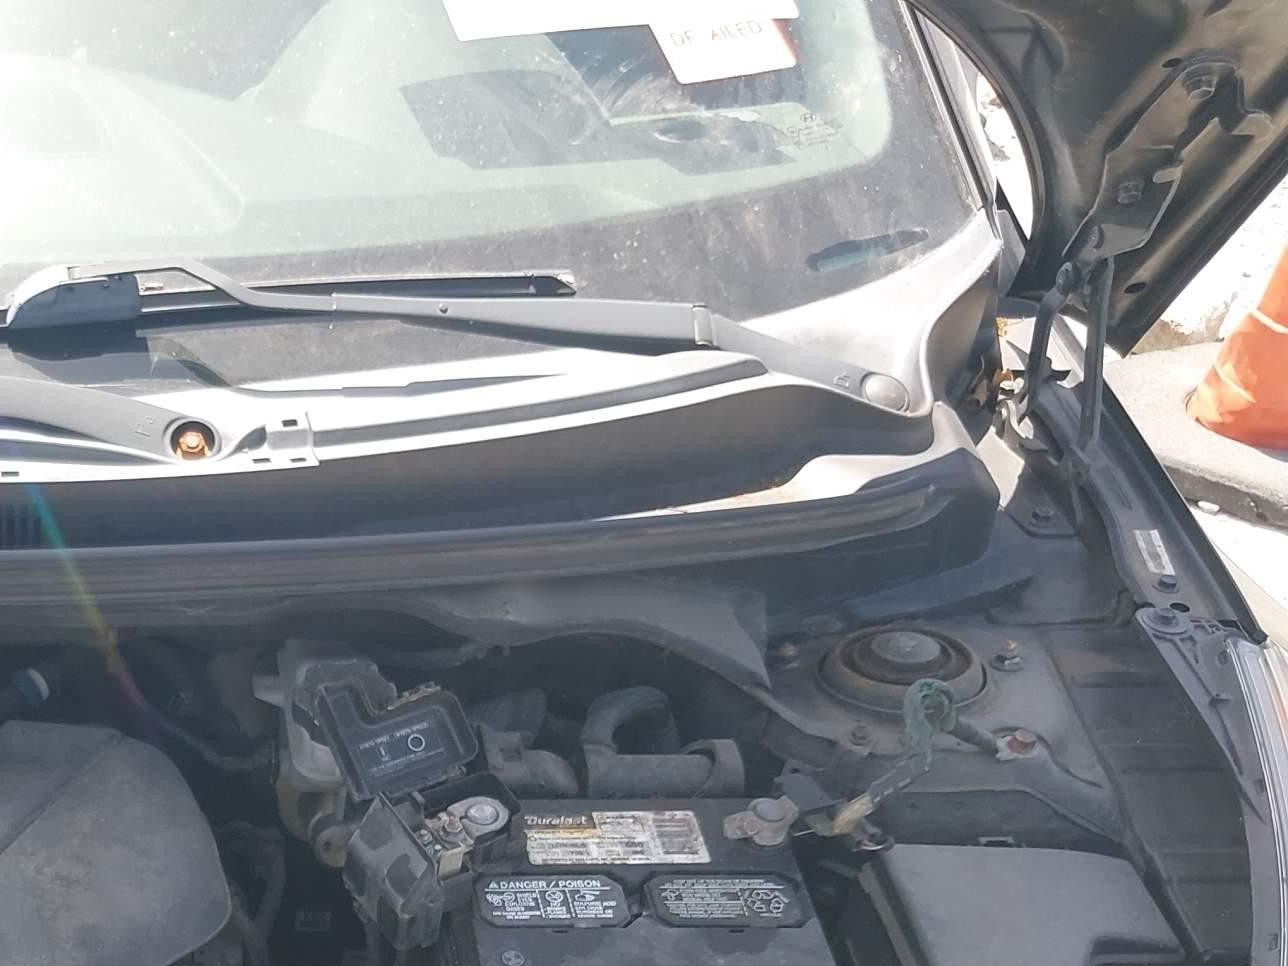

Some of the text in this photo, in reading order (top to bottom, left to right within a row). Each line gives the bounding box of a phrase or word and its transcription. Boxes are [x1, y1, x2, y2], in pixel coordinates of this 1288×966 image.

[525, 816, 587, 825] Duralast
[499, 881, 546, 889] DANGER
[558, 880, 601, 888] POISON
